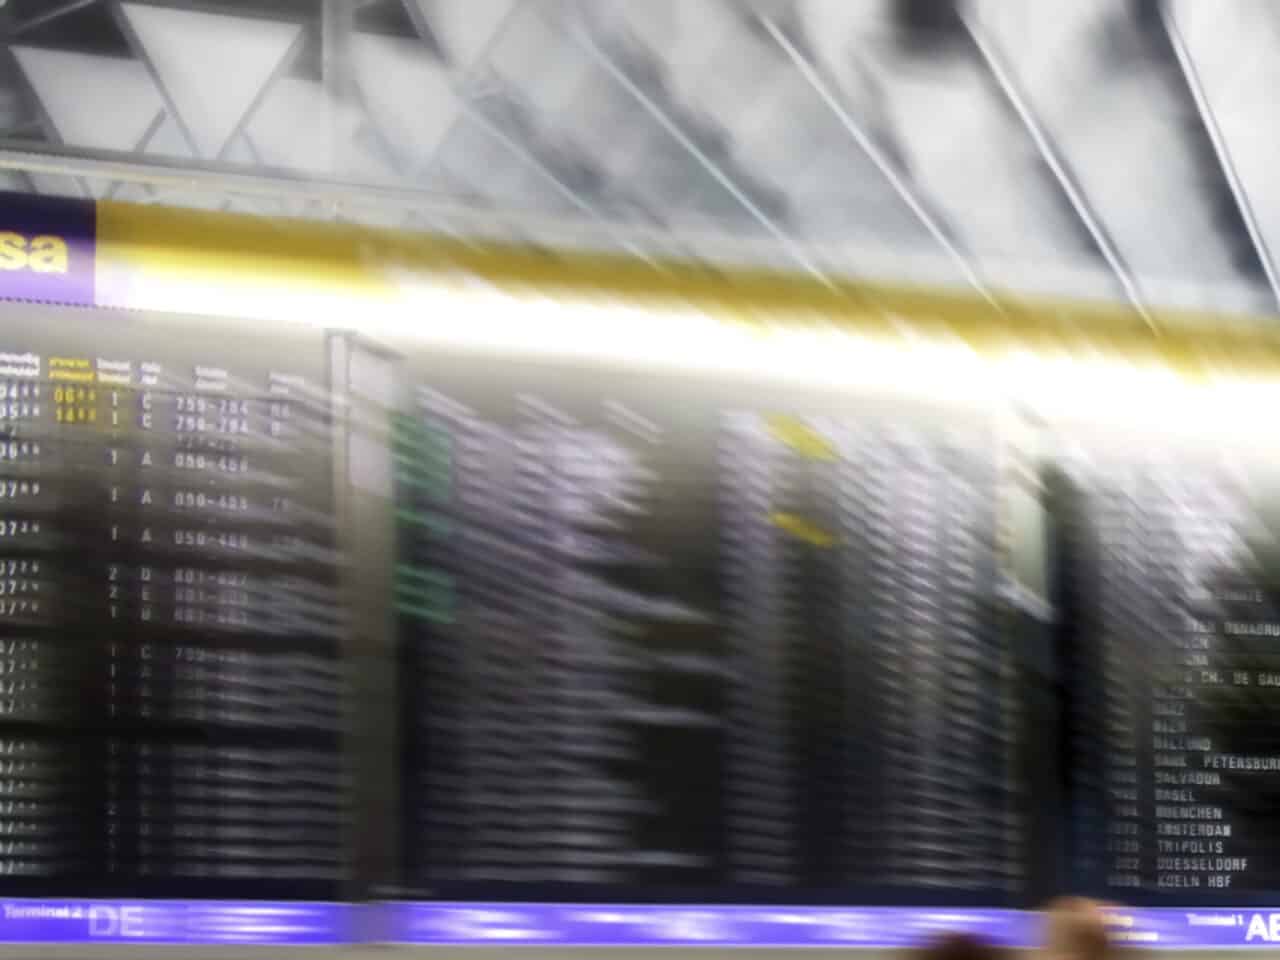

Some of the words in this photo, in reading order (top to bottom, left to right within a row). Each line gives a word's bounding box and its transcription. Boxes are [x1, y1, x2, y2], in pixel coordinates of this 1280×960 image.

[0, 231, 68, 273] sa
[1154, 772, 1220, 784] SALVADOR
[1156, 805, 1222, 818] MUENCHEN
[1156, 824, 1231, 836] AMSTERDAM
[1158, 840, 1224, 854] TRIPOLIS
[1157, 858, 1247, 871] DUESSELDORF
[89, 906, 144, 936] DE
